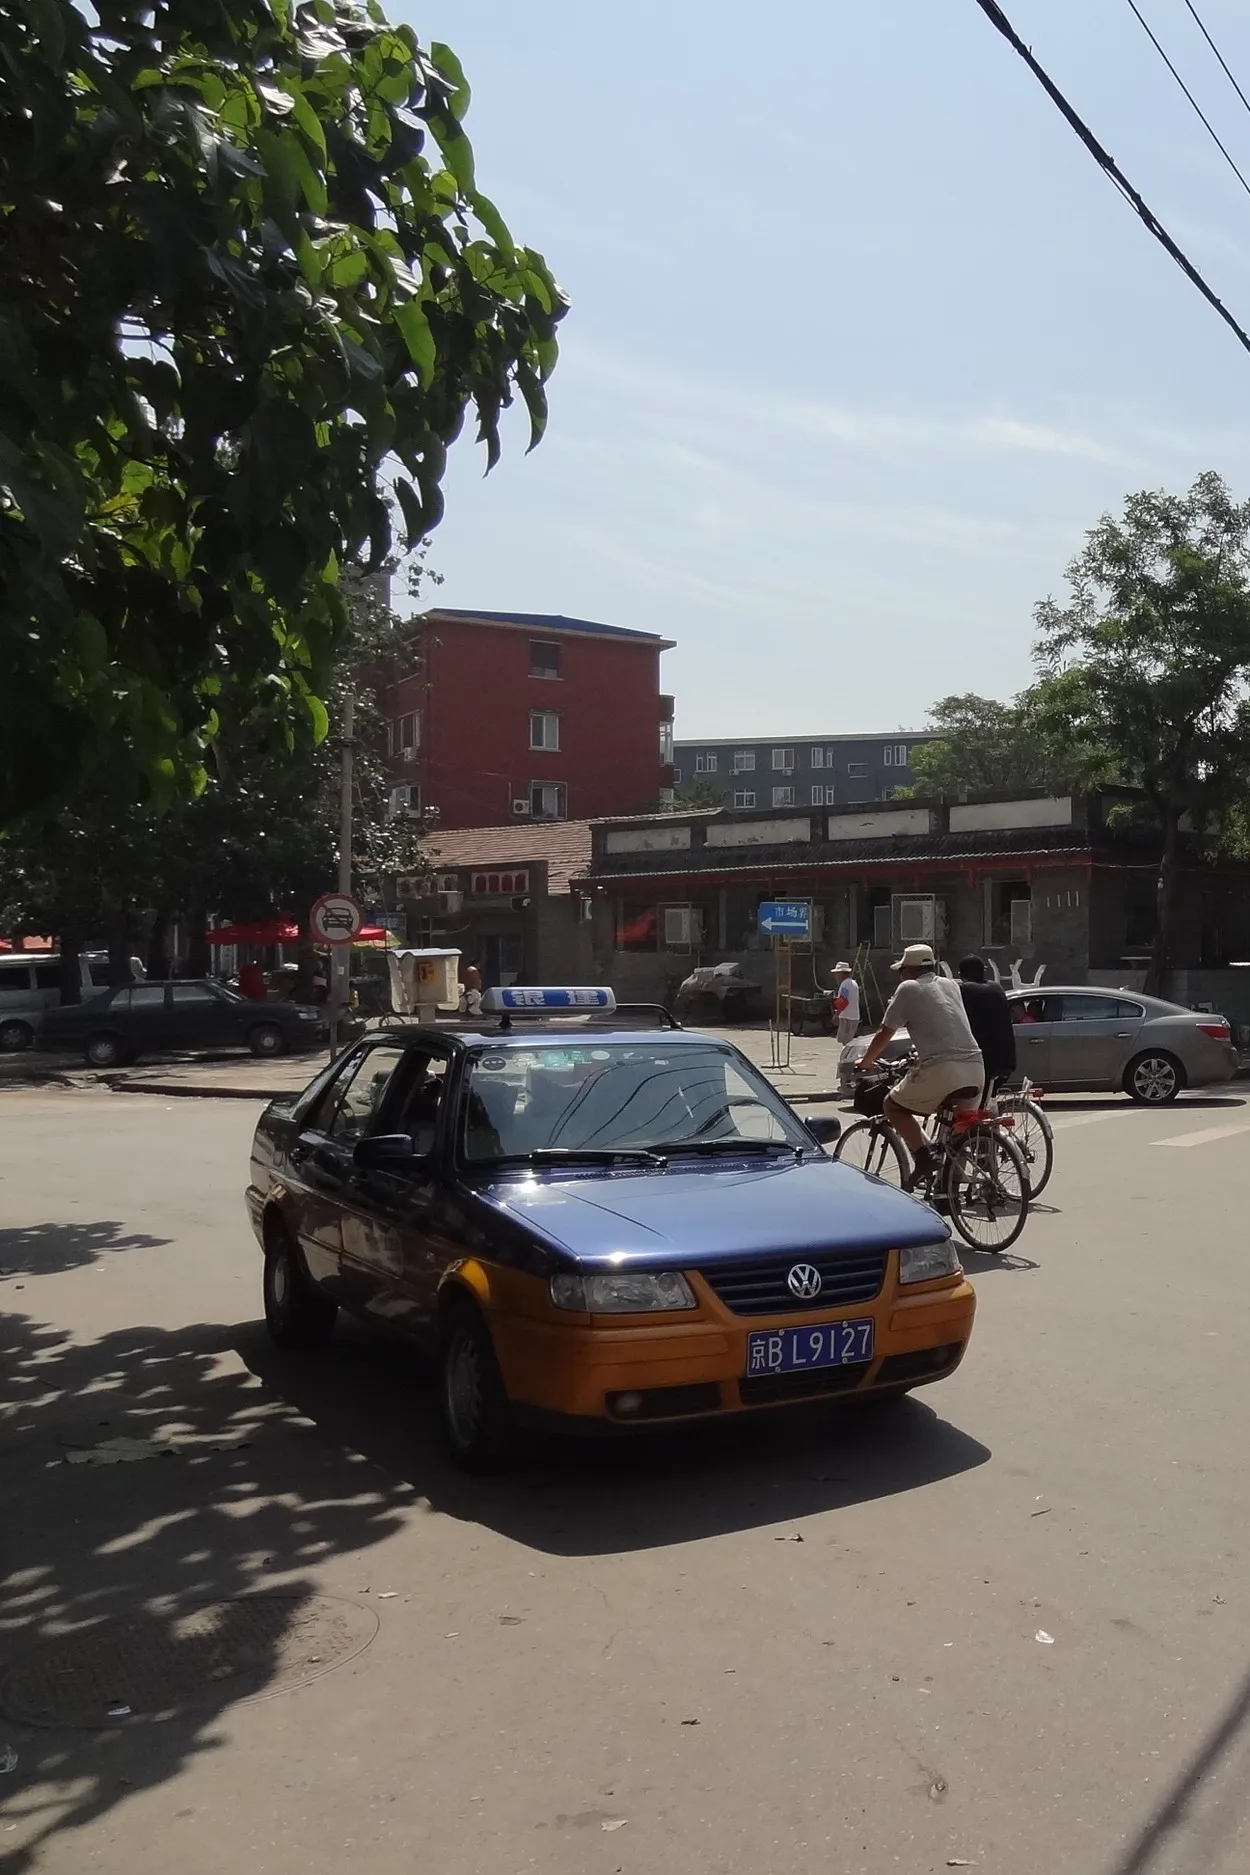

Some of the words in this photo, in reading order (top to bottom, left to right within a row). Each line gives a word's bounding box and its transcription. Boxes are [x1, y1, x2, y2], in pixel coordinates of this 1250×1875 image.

[511, 990, 600, 1006] 银建
[751, 1337, 783, 1369] 京B
[792, 1325, 871, 1364] L9127
